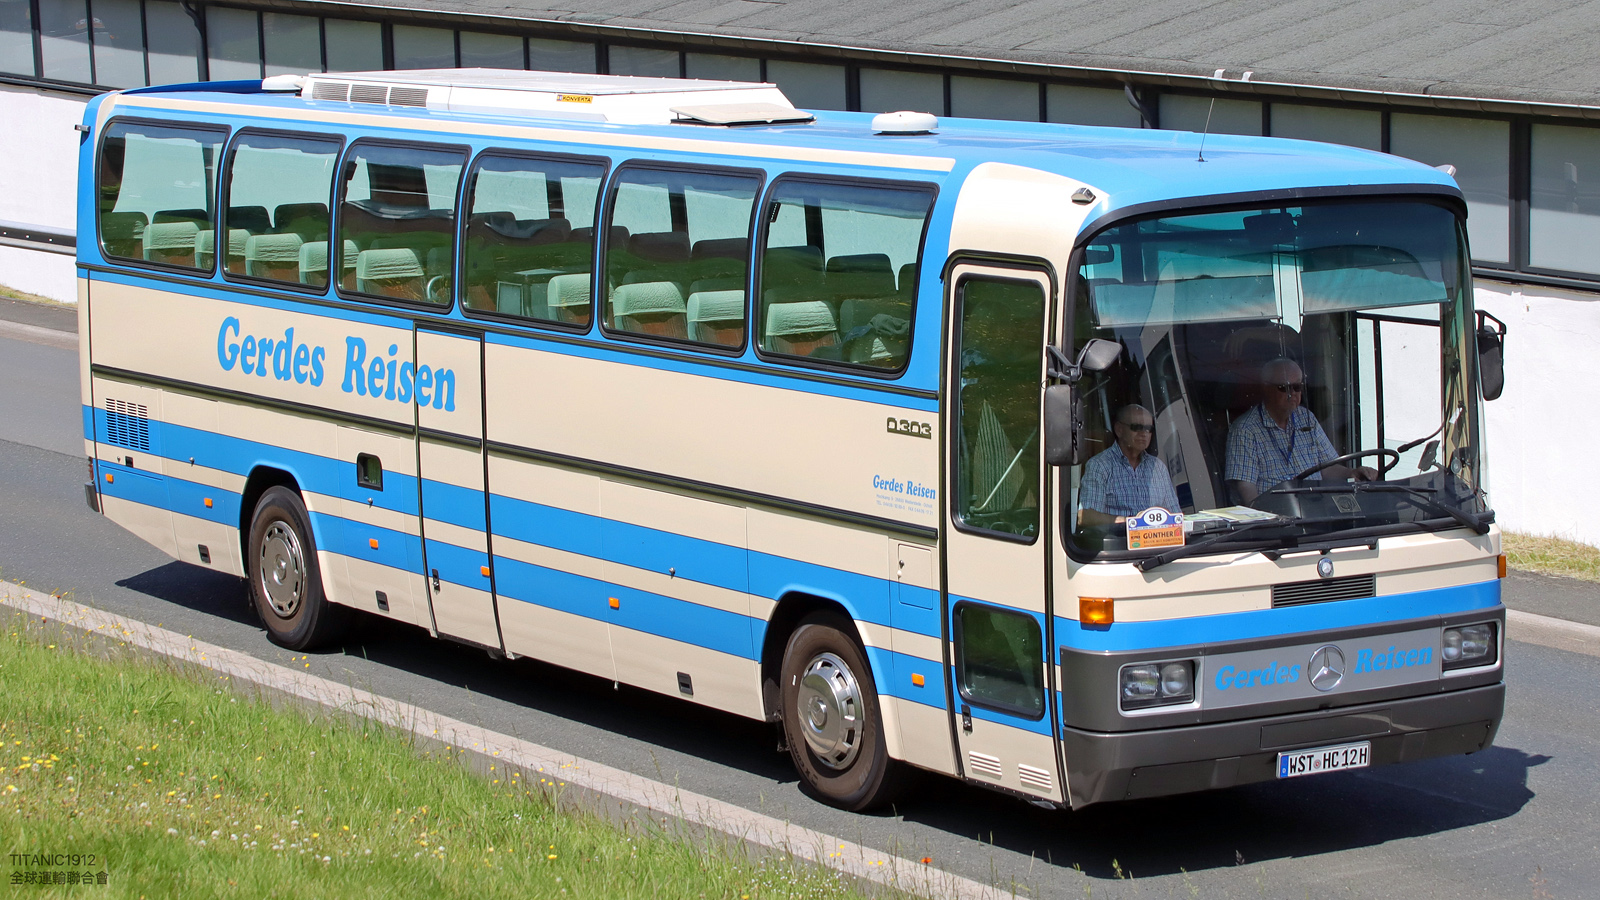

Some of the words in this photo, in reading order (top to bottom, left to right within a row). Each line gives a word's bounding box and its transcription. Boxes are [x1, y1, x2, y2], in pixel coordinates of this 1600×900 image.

[217, 316, 325, 387] Gerdes
[341, 335, 456, 412] Reisen
[873, 474, 904, 494] Gerdes
[906, 480, 936, 499] Reisen
[1149, 513, 1162, 522] 98
[1143, 531, 1173, 539] GÜNTHER
[1215, 661, 1300, 690] Gerdes
[1354, 646, 1433, 674] Reisen
[1289, 754, 1314, 774] WST
